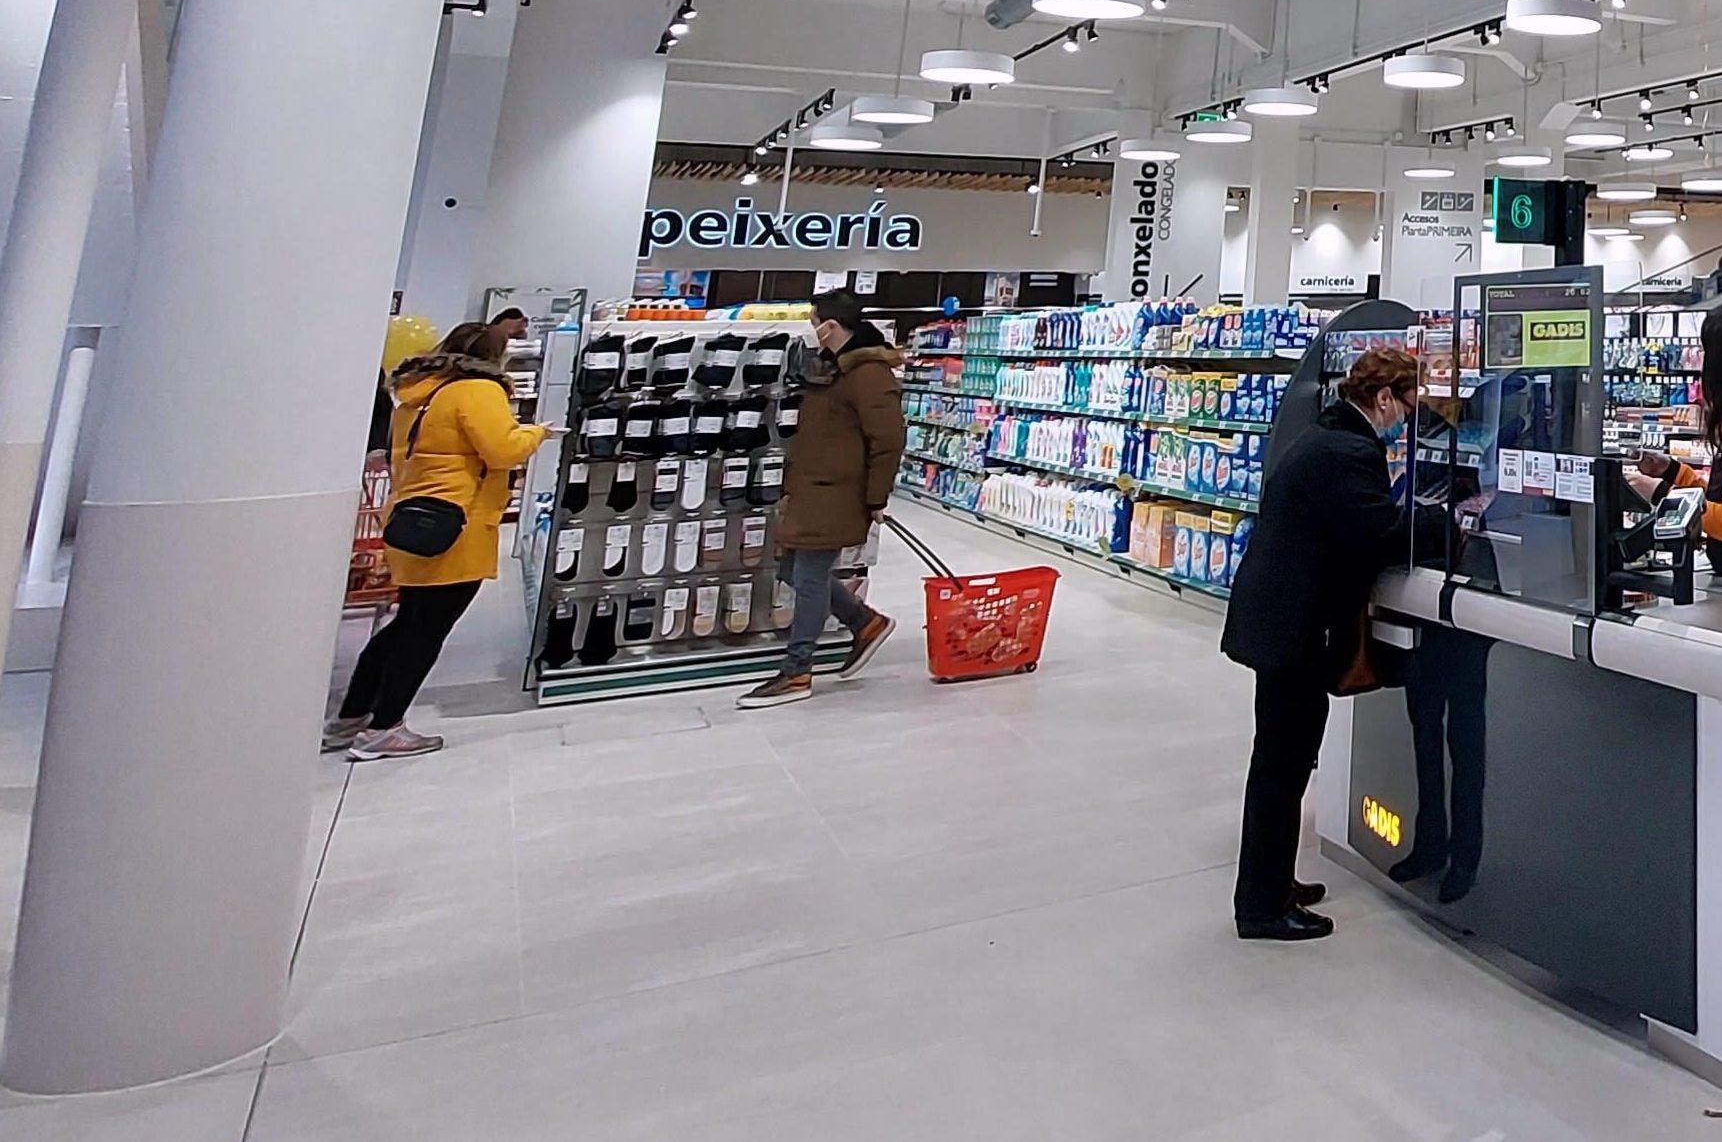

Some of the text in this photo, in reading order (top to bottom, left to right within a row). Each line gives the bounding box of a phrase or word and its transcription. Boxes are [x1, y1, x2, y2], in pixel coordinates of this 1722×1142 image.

[638, 198, 920, 258] peixería
[1402, 213, 1439, 224] Accesos
[1511, 194, 1532, 229] 6
[1130, 162, 1158, 301] onxelado
[1300, 275, 1355, 287] carnicería
[1532, 322, 1584, 339] GADIS
[1362, 795, 1400, 847] GADIS
